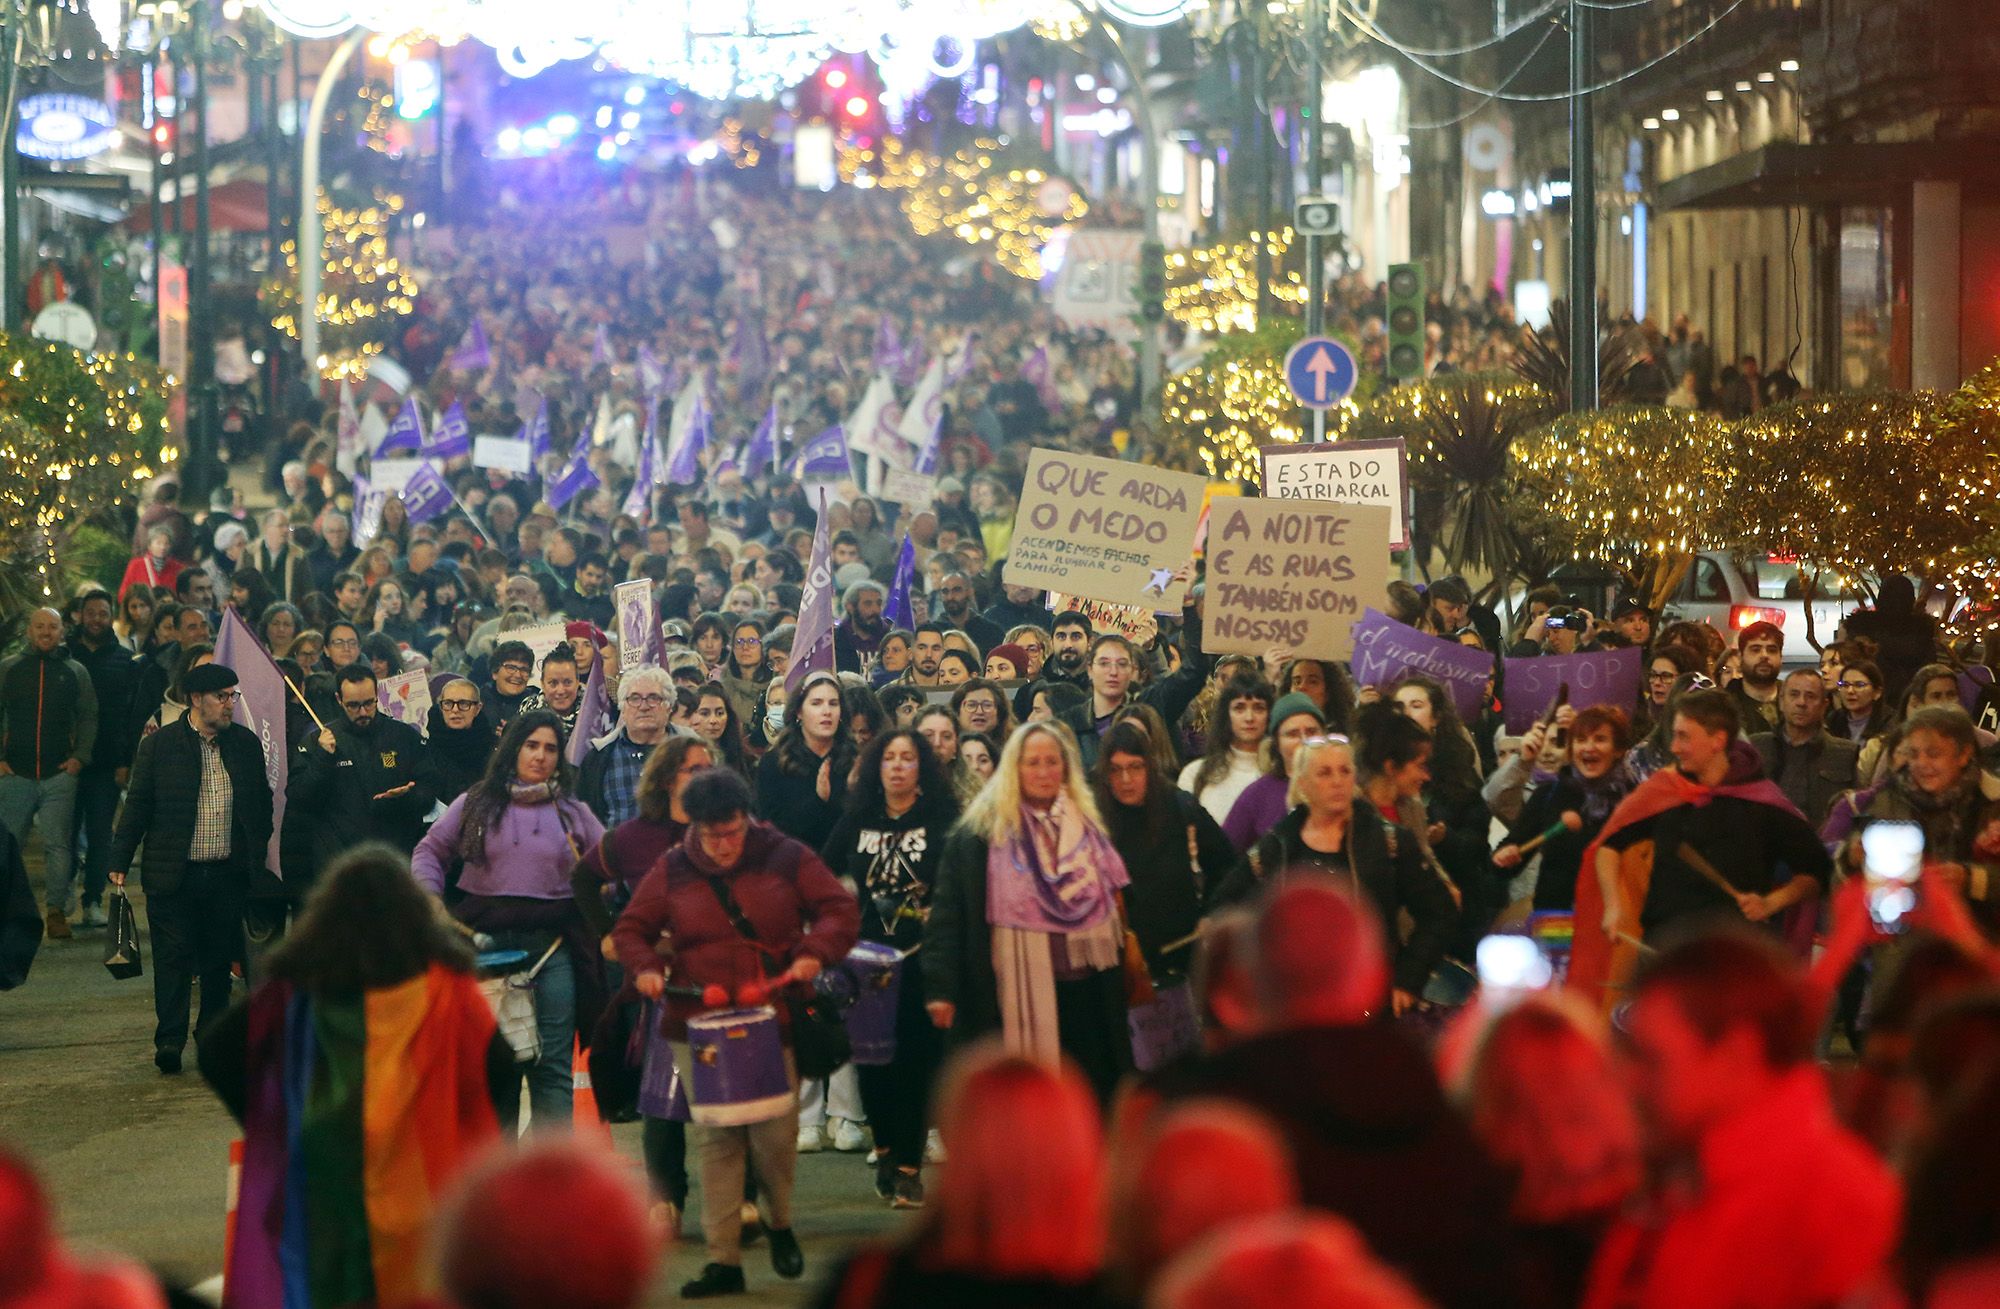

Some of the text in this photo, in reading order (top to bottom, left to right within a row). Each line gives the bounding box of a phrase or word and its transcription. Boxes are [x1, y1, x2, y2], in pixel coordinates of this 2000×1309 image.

[1037, 461, 1187, 513] QUE ARDA
[1278, 460, 1380, 483] ESTADO
[1280, 483, 1390, 499] PATRIARCAL
[1031, 503, 1167, 544] O MEDO
[1222, 509, 1350, 547] A NOITE
[1015, 548, 1122, 574] PARA ILUMINAR O
[1020, 536, 1151, 567] ACENDEMOS FACHOS
[1214, 549, 1356, 582] E AS RUAS
[1217, 582, 1358, 615] TAMBÉN SOM
[1214, 613, 1309, 647] NOSSAS
[1384, 640, 1490, 686] machismo
[1523, 658, 1622, 693] STOP
